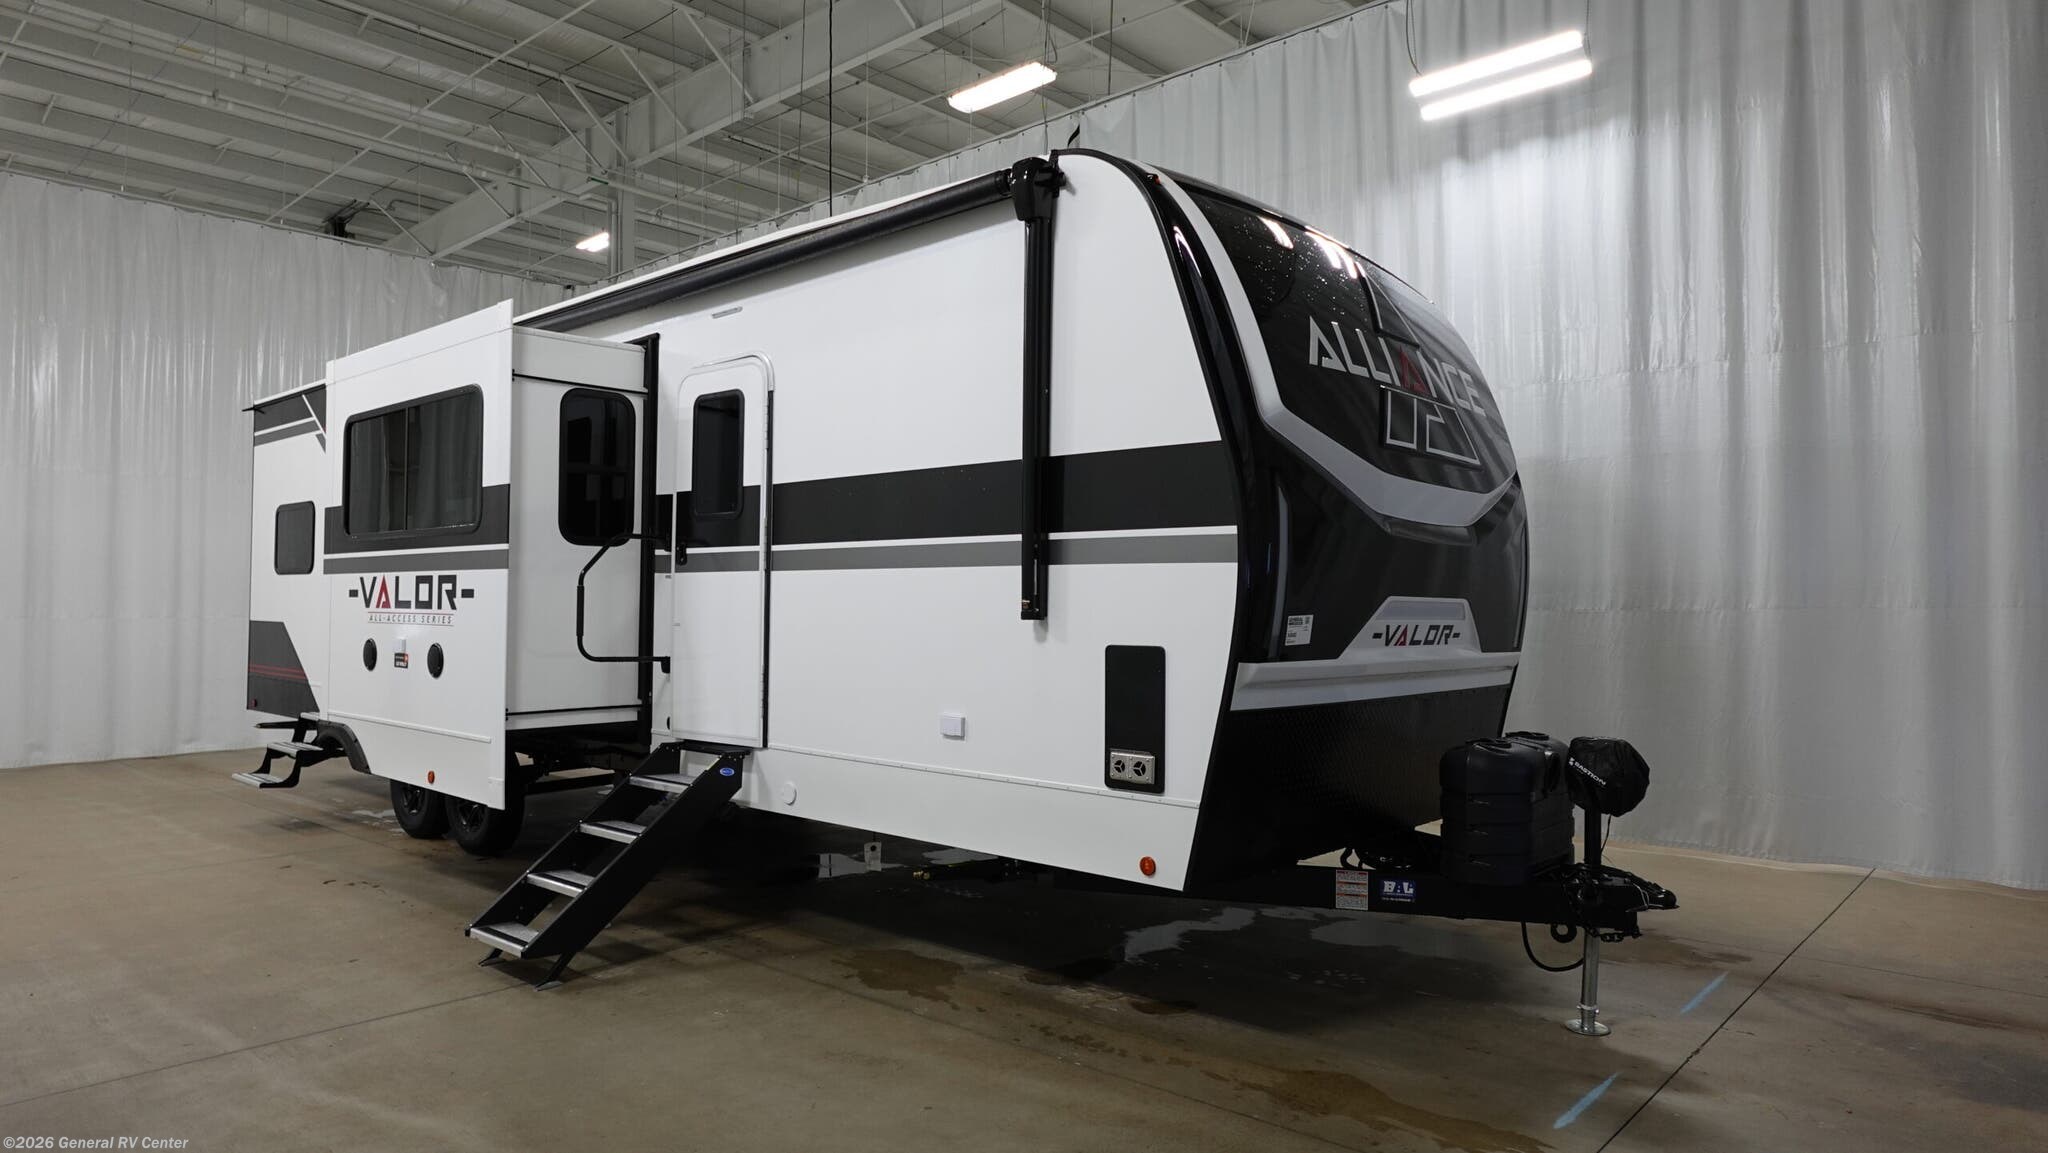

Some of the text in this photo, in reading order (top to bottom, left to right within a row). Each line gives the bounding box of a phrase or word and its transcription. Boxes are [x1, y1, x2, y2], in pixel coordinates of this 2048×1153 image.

[1309, 315, 1486, 417] ALLIANCE
[369, 614, 453, 625] ALL-ACCESS SERIES
[1574, 761, 1607, 786] BASTION
